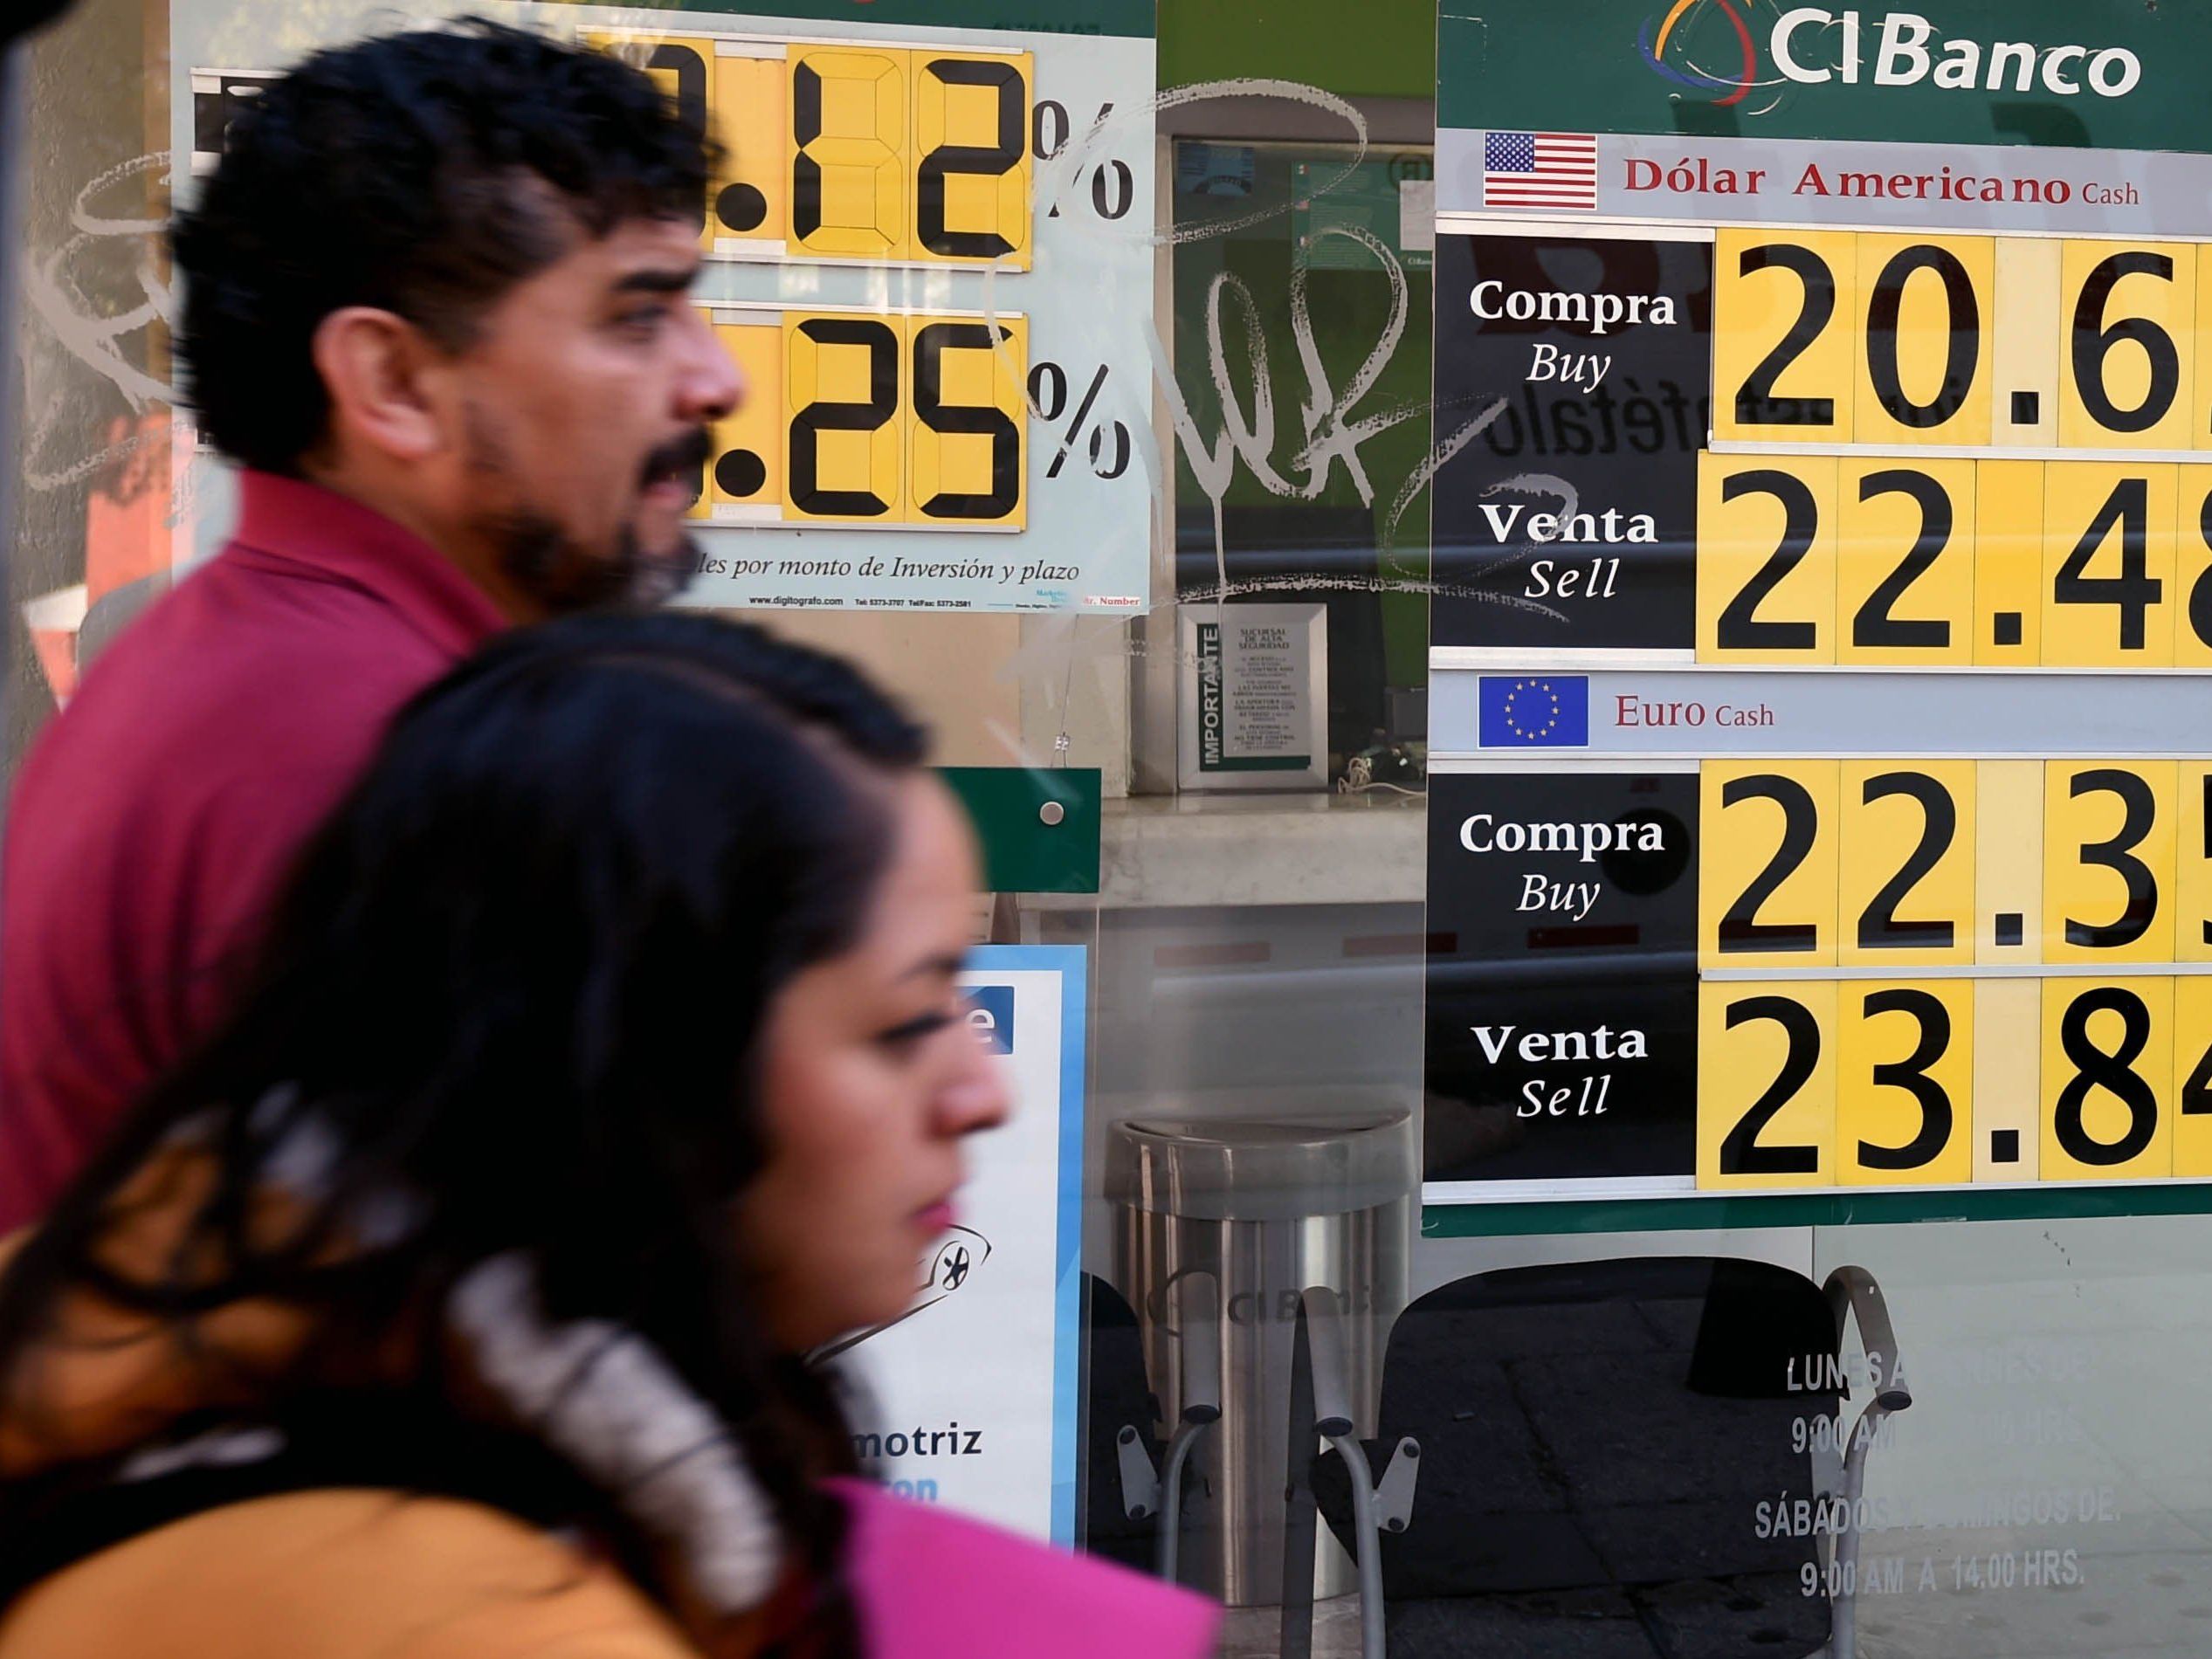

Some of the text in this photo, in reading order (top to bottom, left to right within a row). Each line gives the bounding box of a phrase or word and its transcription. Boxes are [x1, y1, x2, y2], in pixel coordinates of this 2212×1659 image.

[1771, 8, 2141, 97] CIBanco
[1624, 157, 2139, 206] Dólar Americano Cash
[1470, 280, 1677, 334] Compra
[1526, 343, 1611, 394] Buy
[1027, 362, 1131, 479] %
[1478, 504, 1659, 544] Venta
[731, 558, 773, 580] por
[778, 558, 851, 576] monto
[858, 556, 885, 577] de
[890, 556, 994, 580] Inversión
[999, 565, 1015, 584] y
[1019, 560, 1079, 585] plazo
[1525, 558, 1621, 598] Sell
[1717, 469, 2212, 651] 22.4
[749, 595, 844, 607] www.digitografo.com
[1203, 628, 1219, 764] IMPORTANTE
[1615, 695, 1774, 726] Euro Cash
[1459, 814, 1665, 863] Compra
[1718, 768, 2212, 954] 22.3
[1515, 874, 1601, 922] Buy
[1470, 1025, 1649, 1064] Venta
[1516, 1074, 1611, 1118] Sell
[1788, 1352, 1883, 1391] LUNES
[1792, 1413, 1845, 1454] 9:00
[1754, 1490, 1888, 1539] SÁBADOS
[1800, 1548, 2085, 1598] 9:00 AM A 14.00 HRS.
